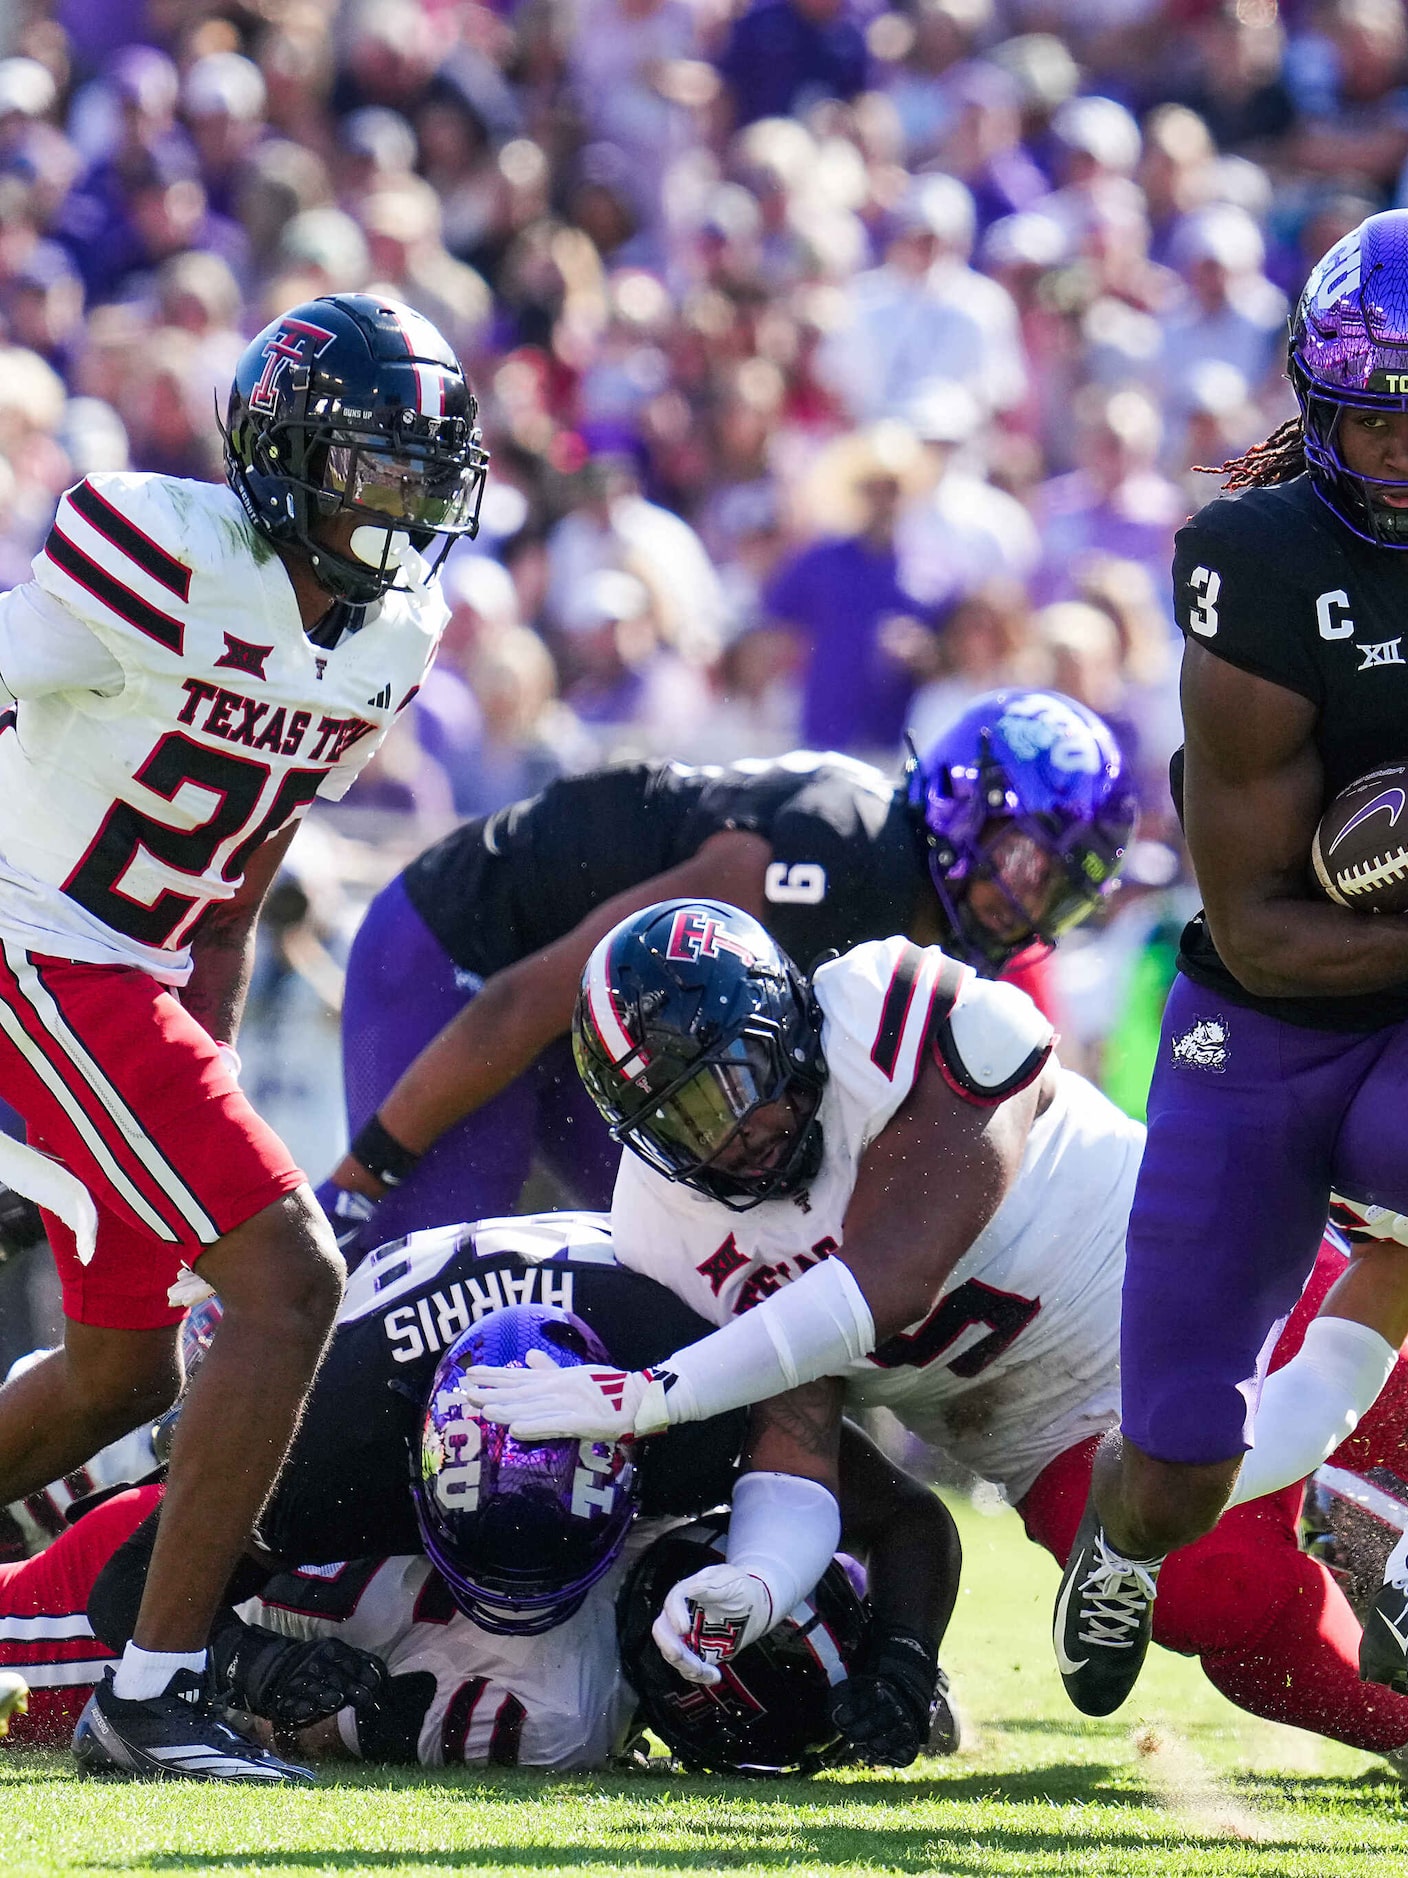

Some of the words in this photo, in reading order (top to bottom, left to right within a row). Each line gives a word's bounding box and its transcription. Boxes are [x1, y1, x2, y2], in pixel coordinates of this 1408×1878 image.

[342, 406, 363, 419] GUNS
[363, 410, 373, 420] UP
[1189, 565, 1222, 639] 3
[1315, 588, 1355, 641] C
[1355, 636, 1407, 672] XII
[177, 677, 313, 757] TEXAS
[383, 1267, 575, 1364] HARRIS
